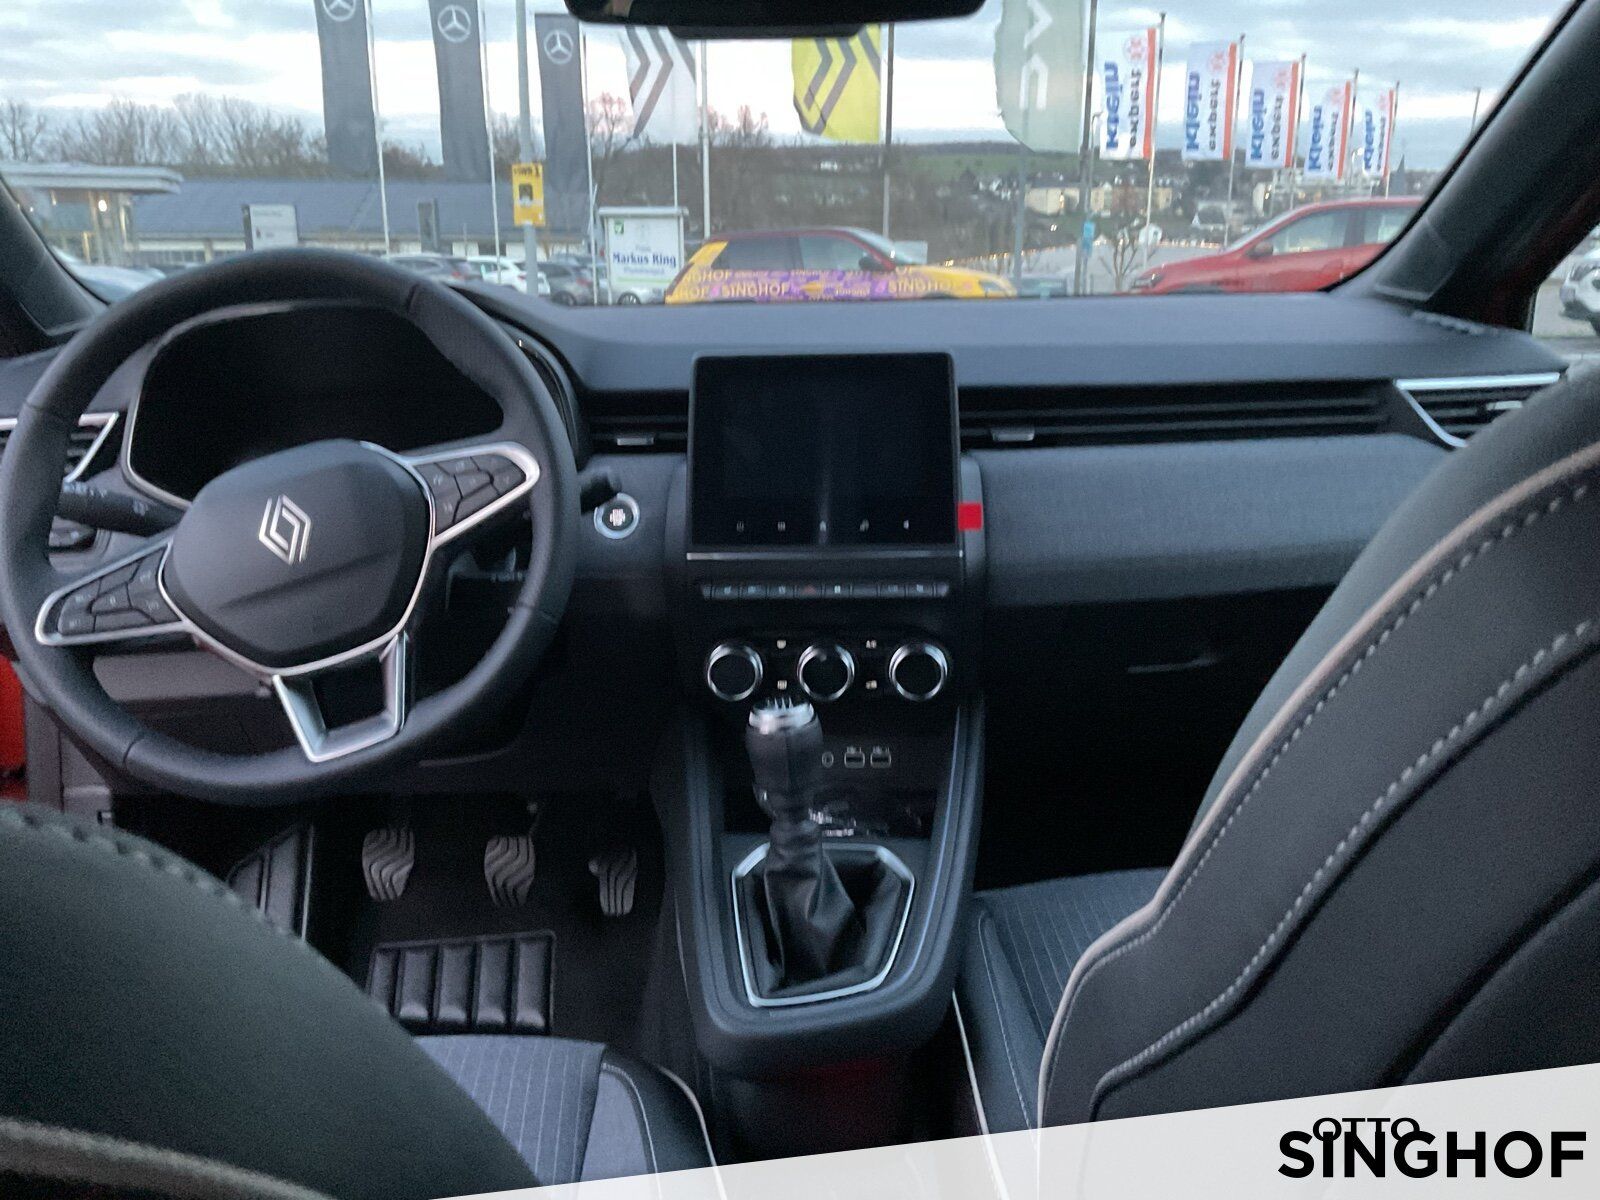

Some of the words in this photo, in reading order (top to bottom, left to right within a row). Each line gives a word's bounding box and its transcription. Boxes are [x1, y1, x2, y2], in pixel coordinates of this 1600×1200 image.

[612, 251, 649, 265] Markus
[652, 253, 676, 269] Ring
[721, 282, 791, 298] SINGHOF
